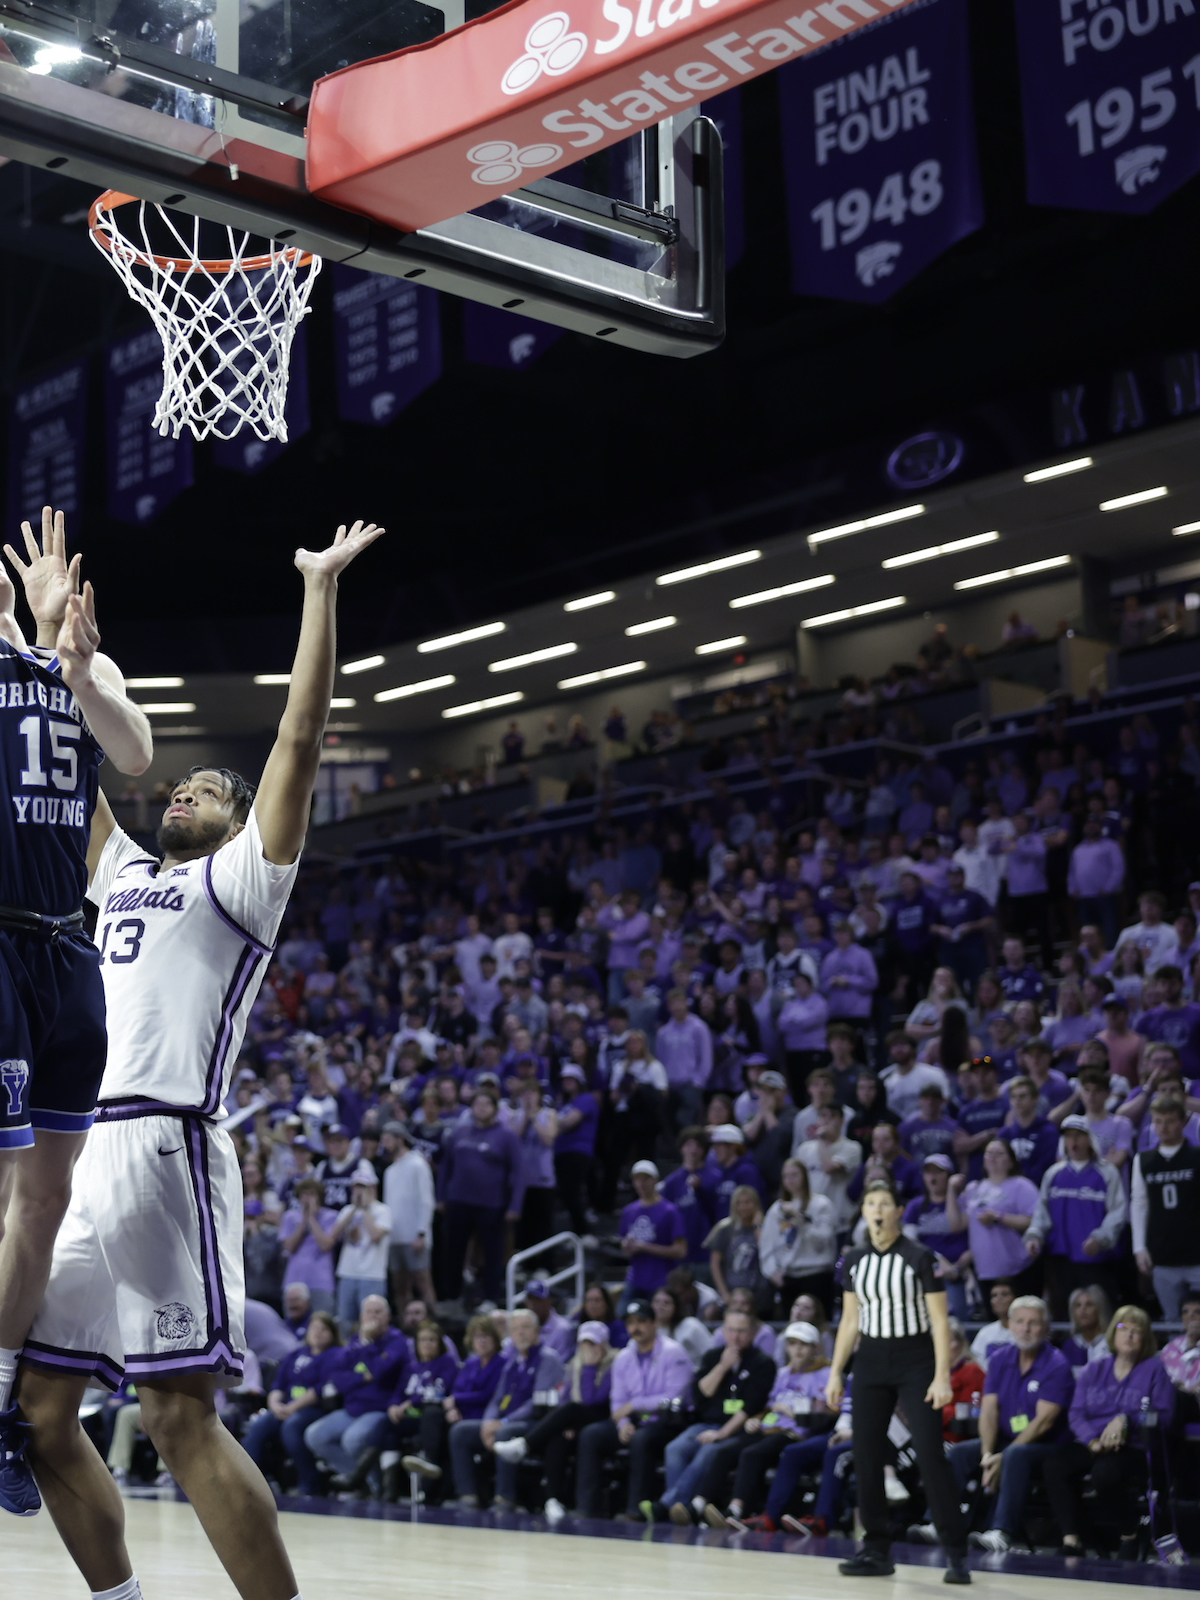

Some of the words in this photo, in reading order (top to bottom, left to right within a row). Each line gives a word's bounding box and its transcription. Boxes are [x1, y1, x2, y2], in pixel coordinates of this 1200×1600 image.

[1062, 0, 1196, 67] FOUR
[813, 46, 931, 126] FINAL
[1065, 52, 1200, 157] 1951
[815, 86, 930, 166] FOUR
[811, 159, 943, 251] 1948
[19, 716, 81, 791] 15
[12, 796, 85, 828] YOUNG
[104, 885, 185, 915] Wildats
[99, 918, 145, 965] 13
[1161, 1183, 1179, 1210] 0
